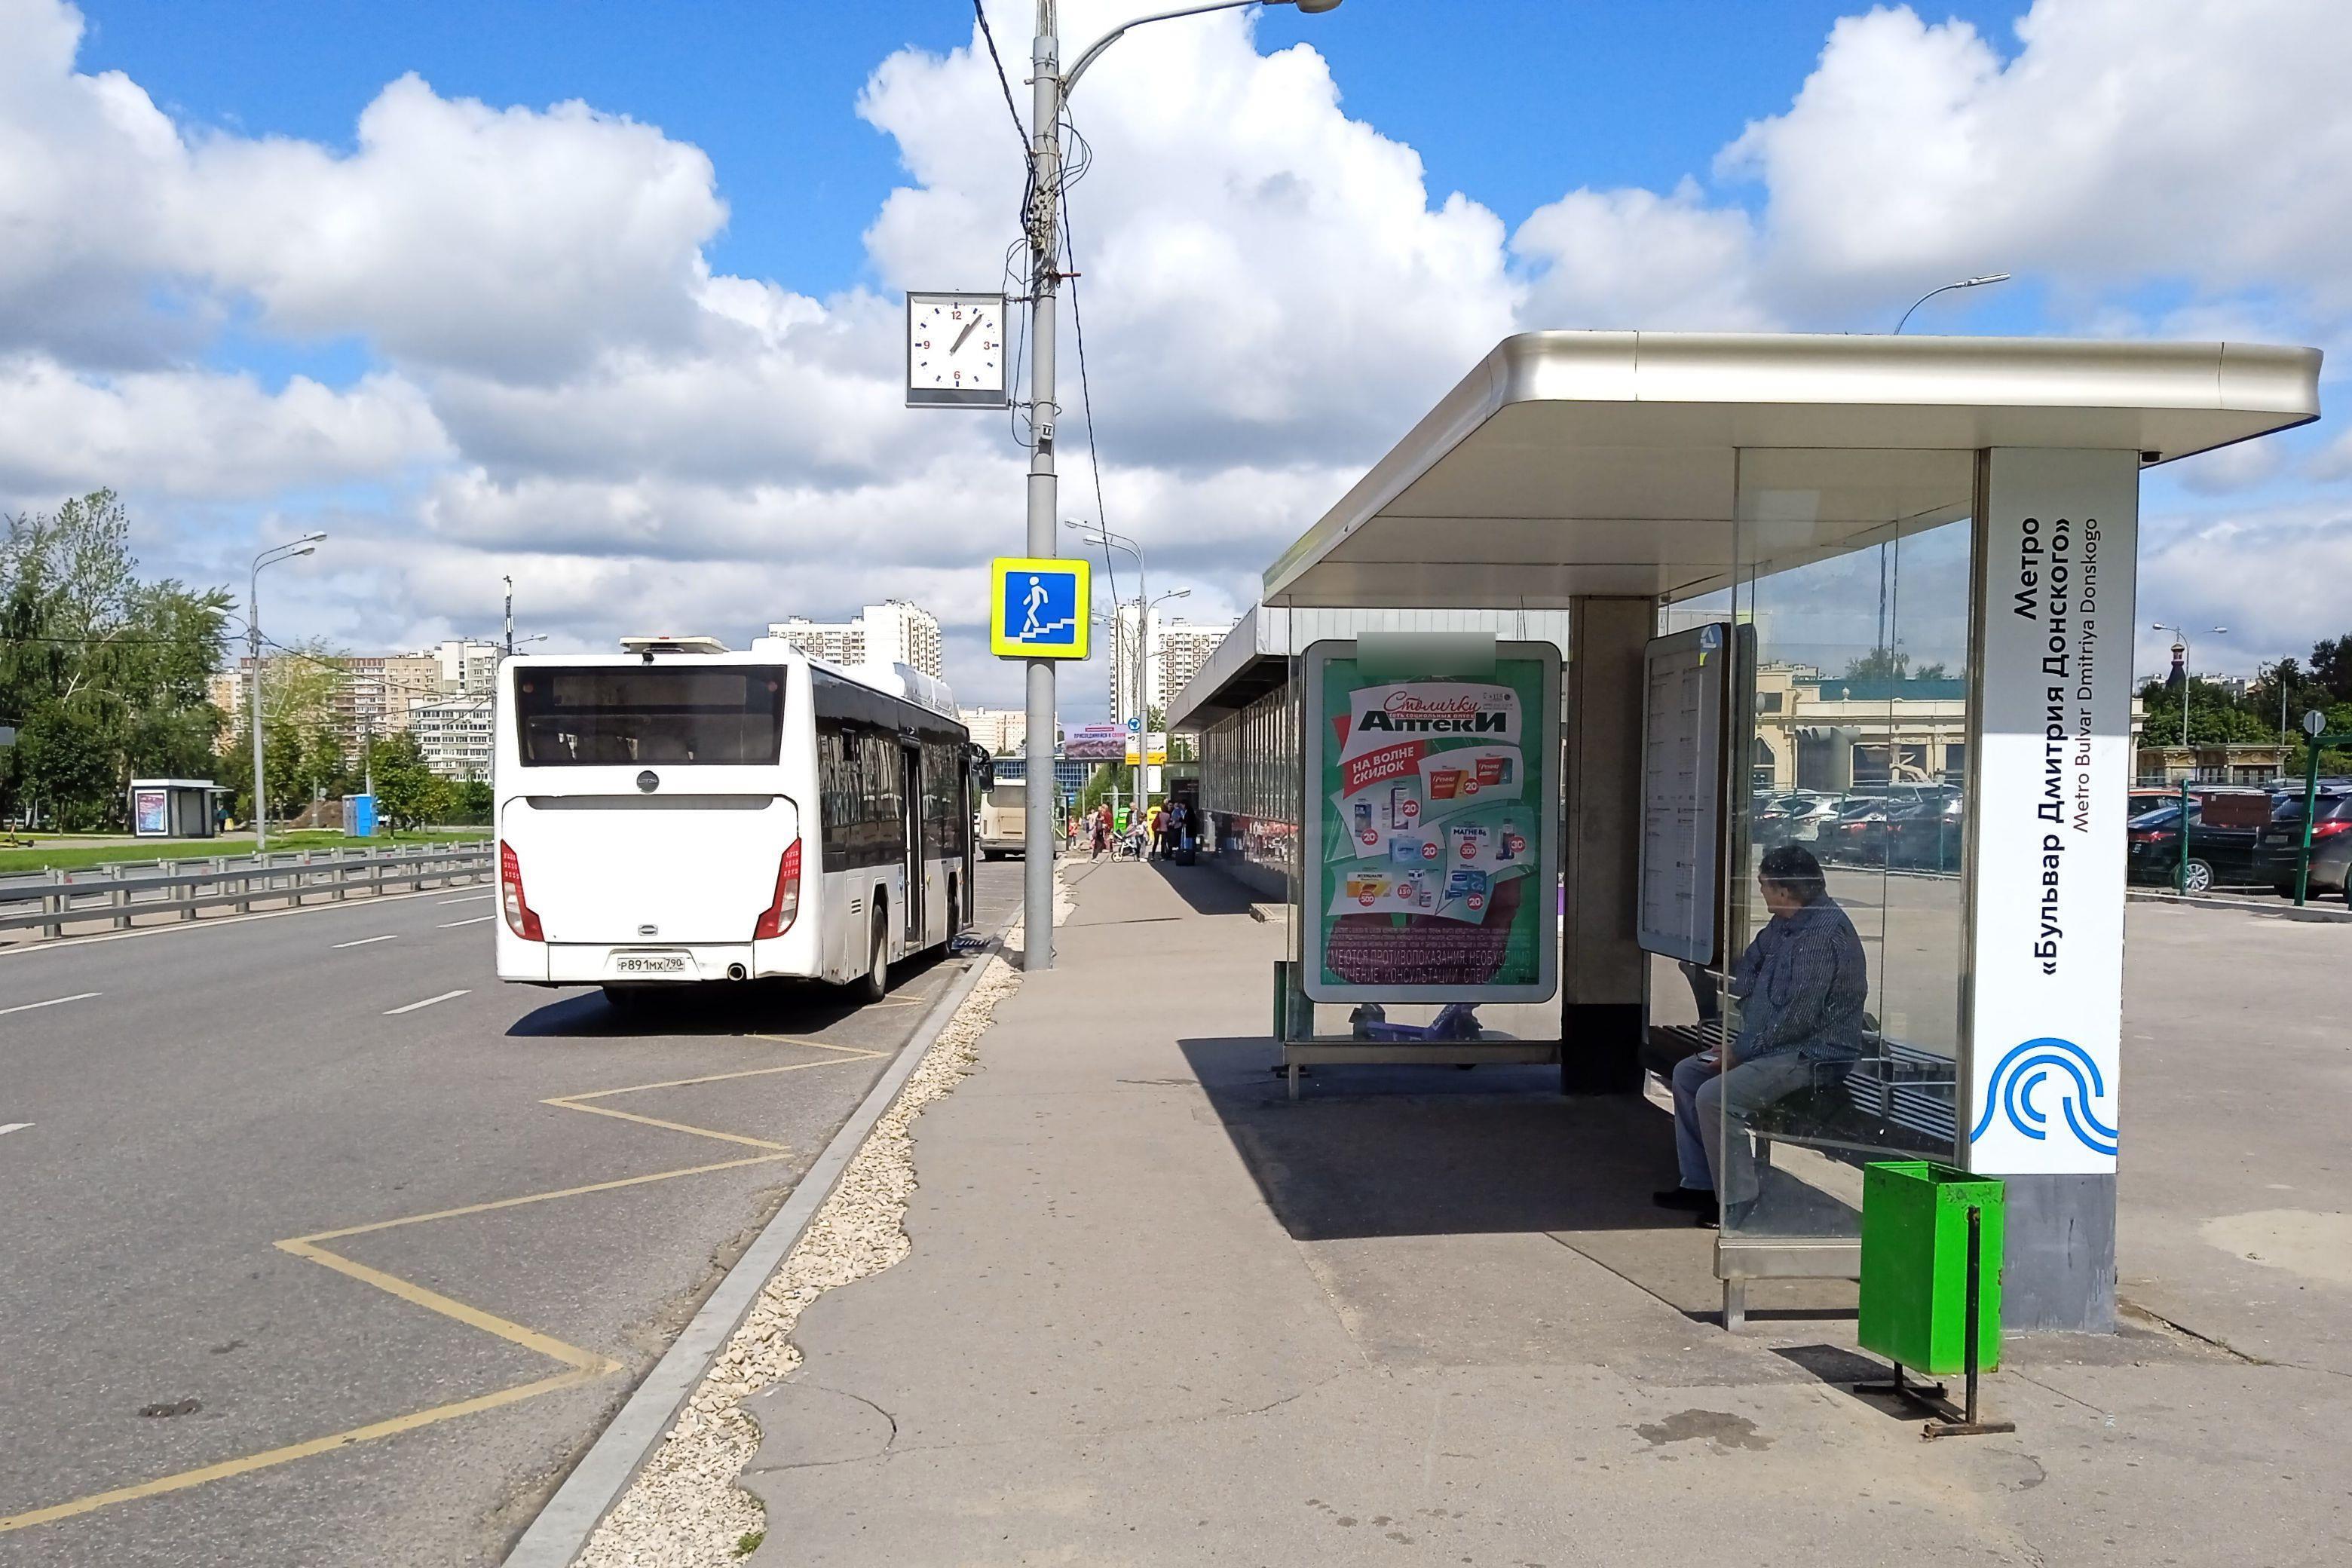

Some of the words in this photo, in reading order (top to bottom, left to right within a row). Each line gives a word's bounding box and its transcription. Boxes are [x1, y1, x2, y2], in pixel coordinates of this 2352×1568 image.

[923, 341, 930, 349] 9
[951, 311, 962, 320] 12
[954, 371, 960, 379] 6
[984, 341, 990, 350] 3
[2014, 517, 2044, 620] Метро
[2080, 518, 2101, 613] Donskogo
[2042, 518, 2070, 678] Донского»
[2077, 620, 2098, 700] Dmitriya
[1352, 761, 1370, 774] НА
[1373, 746, 1414, 766] ВОЛНЕ
[2038, 687, 2069, 823] Дмитрия
[2075, 707, 2092, 766] Bulvar
[1352, 761, 1404, 785] СКИДОК
[2073, 773, 2090, 833] Metro
[2034, 834, 2066, 975] «Бульвар
